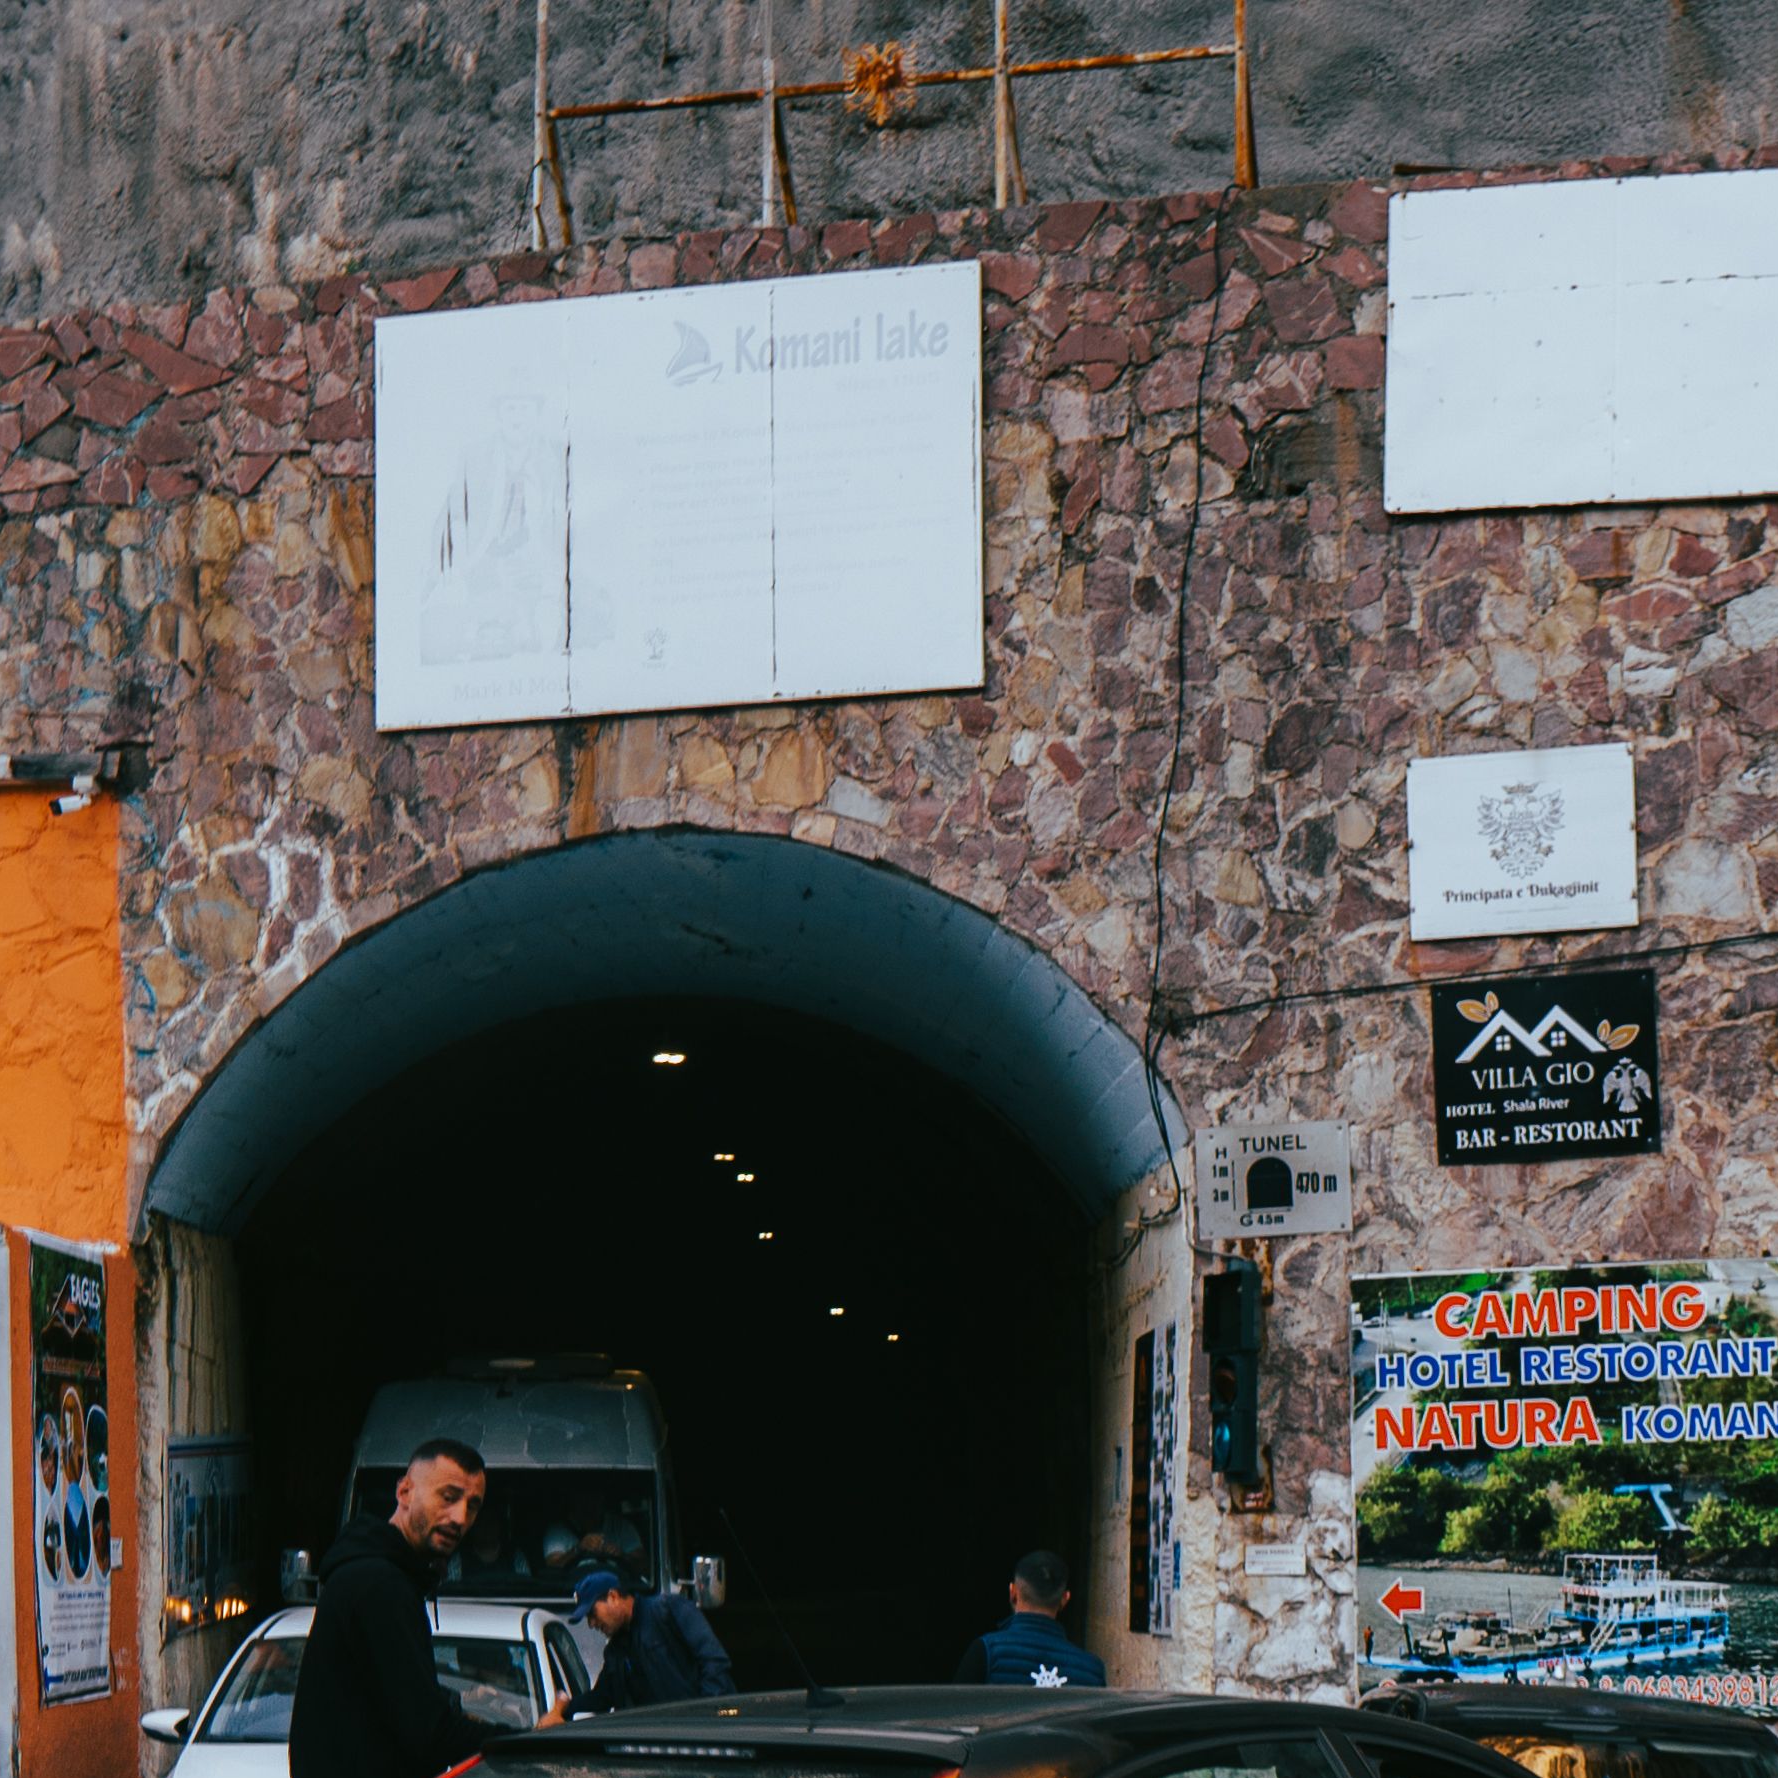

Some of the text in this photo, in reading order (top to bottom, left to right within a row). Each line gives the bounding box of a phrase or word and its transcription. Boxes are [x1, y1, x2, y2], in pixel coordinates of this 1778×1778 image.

[734, 310, 948, 374] Komani lake
[1442, 888, 1513, 904] Principata
[1526, 881, 1599, 898] Dukagjinit
[1471, 1061, 1595, 1090] VILLA GIO
[1446, 1097, 1570, 1118] HOTEL Shala River
[1239, 1134, 1307, 1154] TUNEL
[1456, 1128, 1497, 1150] BAR
[1514, 1117, 1643, 1145] RESTORANT
[1215, 1147, 1227, 1159] H
[70, 1273, 100, 1310] EAGLES
[1433, 1282, 1706, 1338] CAMPING
[1376, 1337, 1778, 1391] HOTEL RESTORANT
[1374, 1396, 1602, 1452] NATURA
